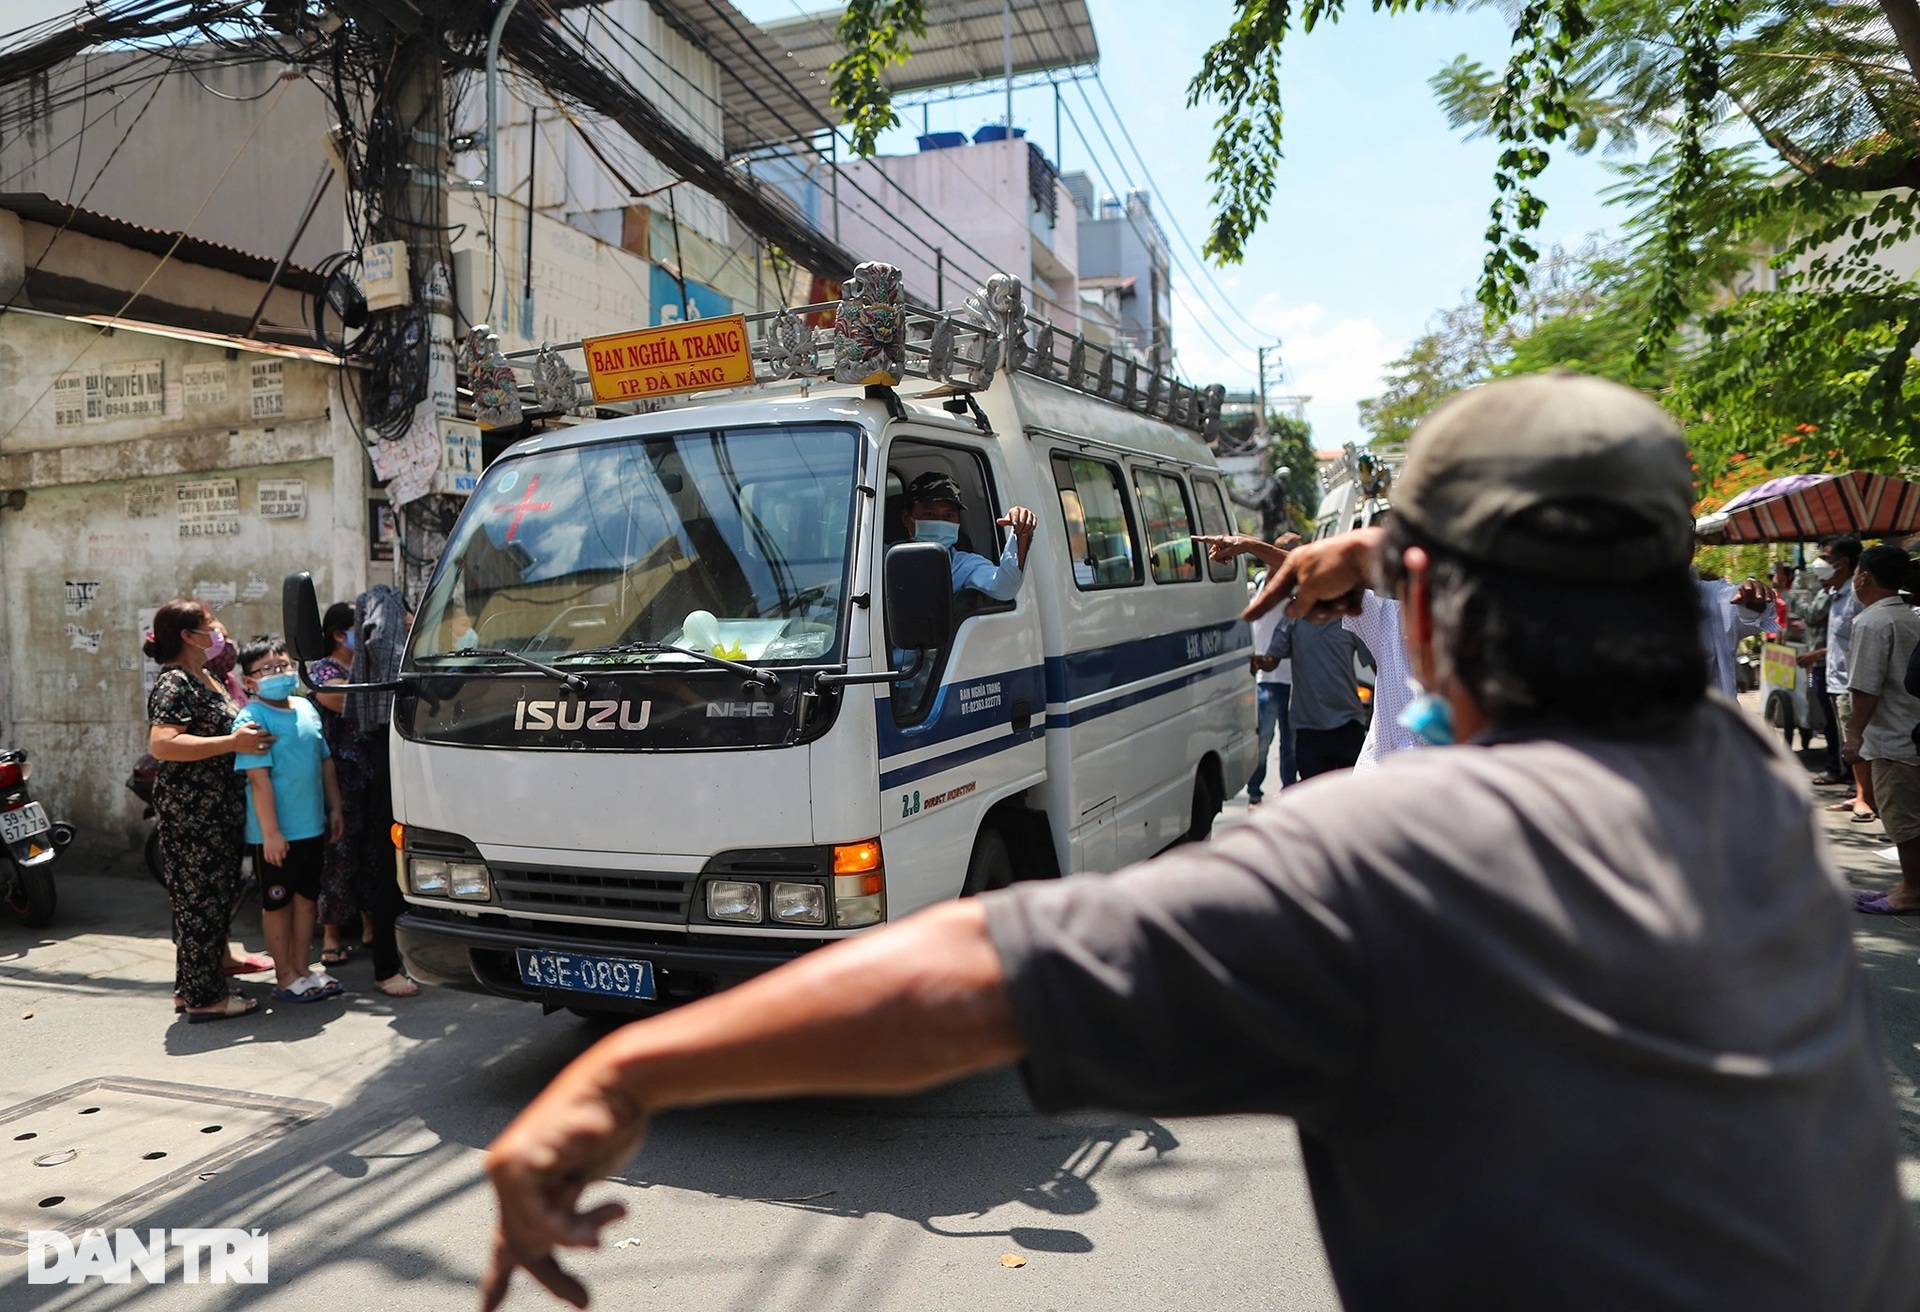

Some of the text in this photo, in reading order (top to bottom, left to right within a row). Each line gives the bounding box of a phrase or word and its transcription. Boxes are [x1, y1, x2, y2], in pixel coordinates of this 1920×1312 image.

[592, 330, 740, 373] BAN NGHĨA TRANG
[617, 379, 642, 395] TP.
[645, 370, 672, 392] ĐÀ
[959, 688, 971, 701] BAN
[985, 681, 1002, 695] TRANG
[514, 700, 652, 731] ISUZU
[705, 701, 774, 718] NHR
[902, 790, 921, 819] 2.8
[527, 953, 645, 994] 43E-0897
